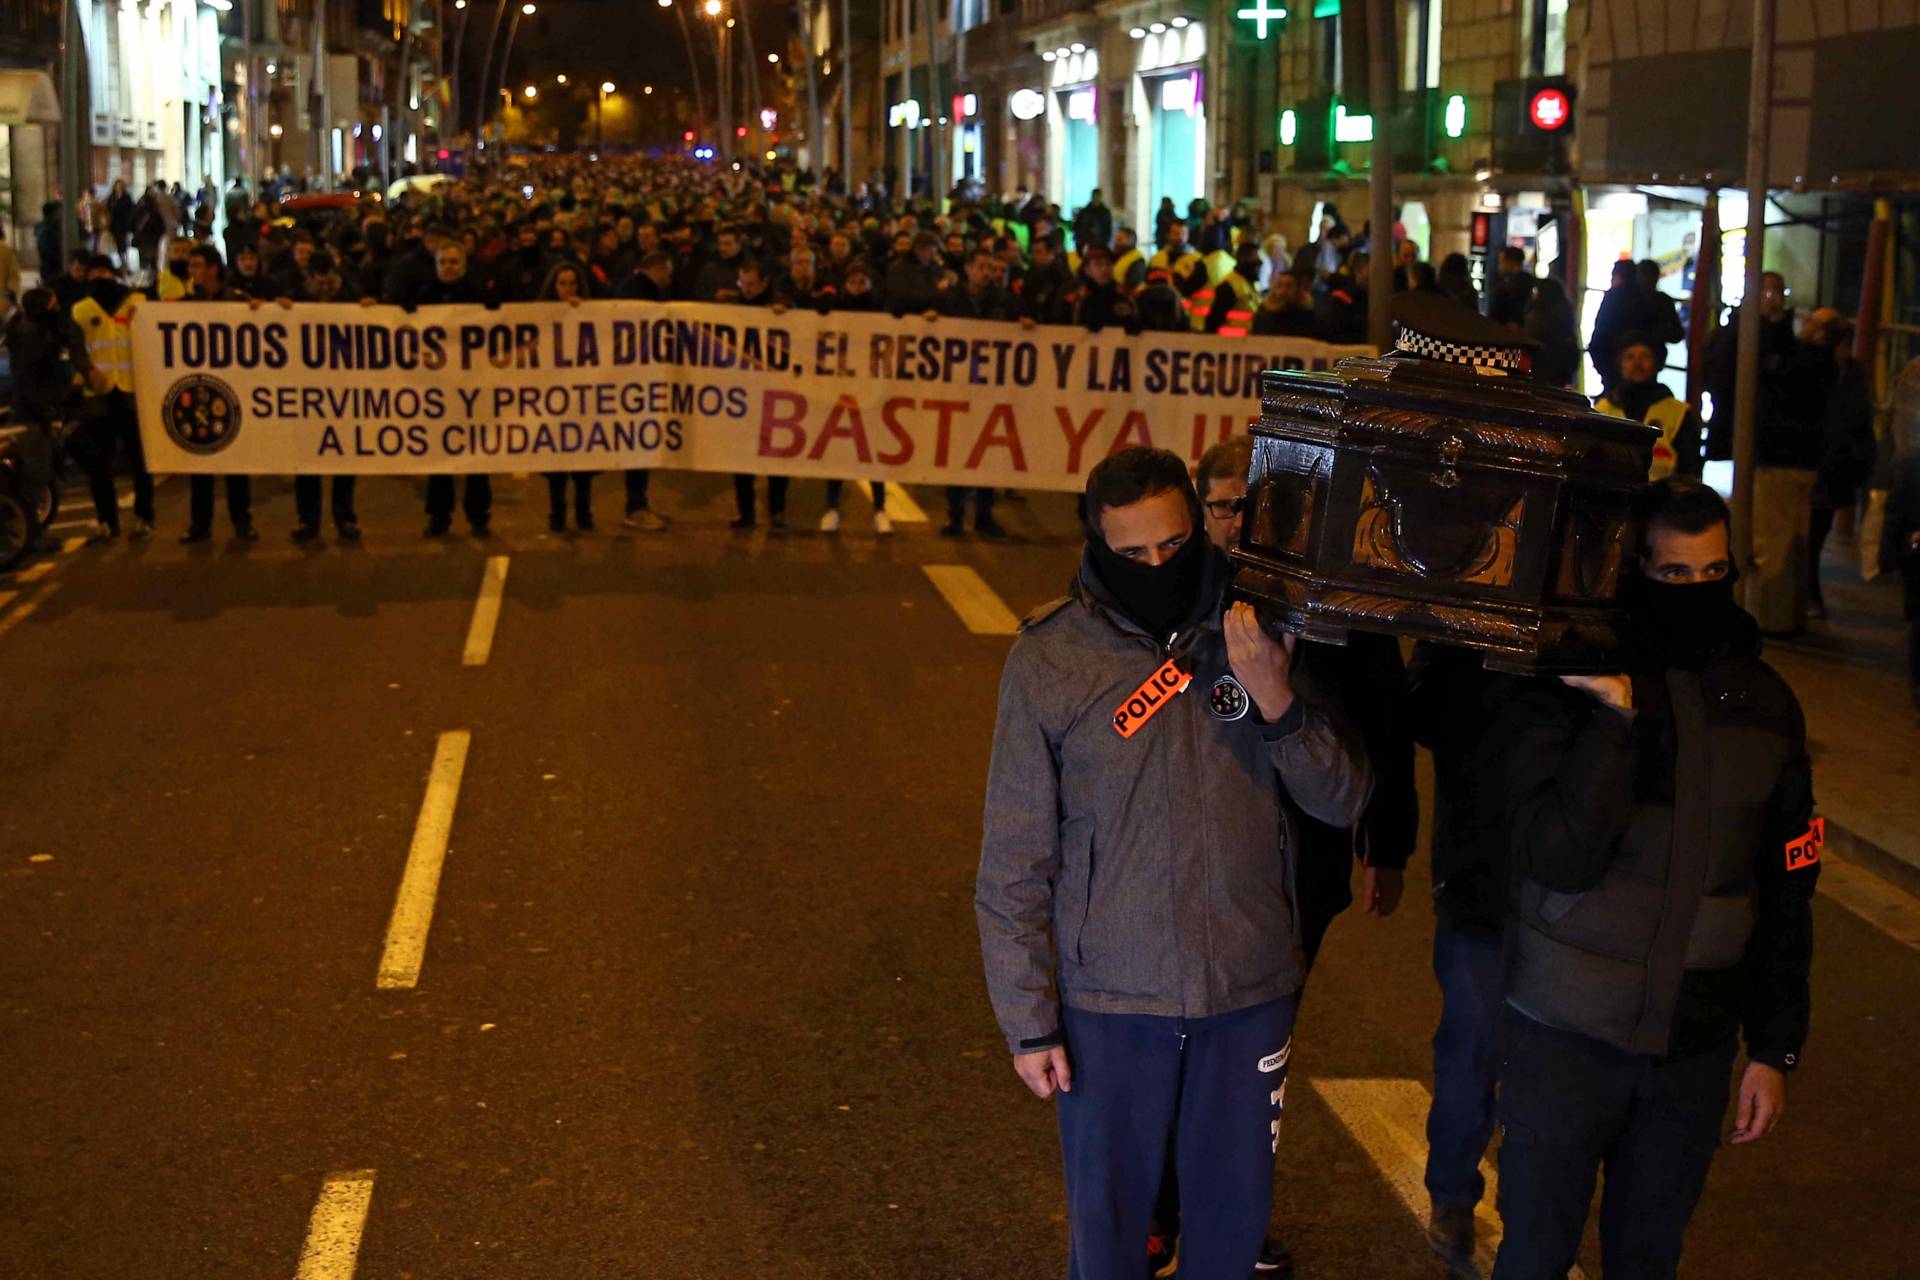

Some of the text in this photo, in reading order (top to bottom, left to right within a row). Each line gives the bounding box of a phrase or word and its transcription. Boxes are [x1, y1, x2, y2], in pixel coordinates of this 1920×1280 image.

[158, 321, 289, 369] TODOS
[301, 323, 448, 370] UNIDOS
[460, 323, 540, 370] POR
[553, 321, 600, 368] LA
[613, 319, 803, 378] DIGNIDAD,
[815, 330, 856, 378] EL
[870, 333, 1038, 387] RESPETO
[1051, 343, 1077, 390] Y
[1087, 346, 1132, 393] LA
[251, 382, 748, 419] SERVIMOS Y PROTEGEMOS
[318, 420, 684, 456] A LOS CIUDADANOS
[757, 389, 1028, 474] BASTA
[1053, 406, 1153, 474] YA
